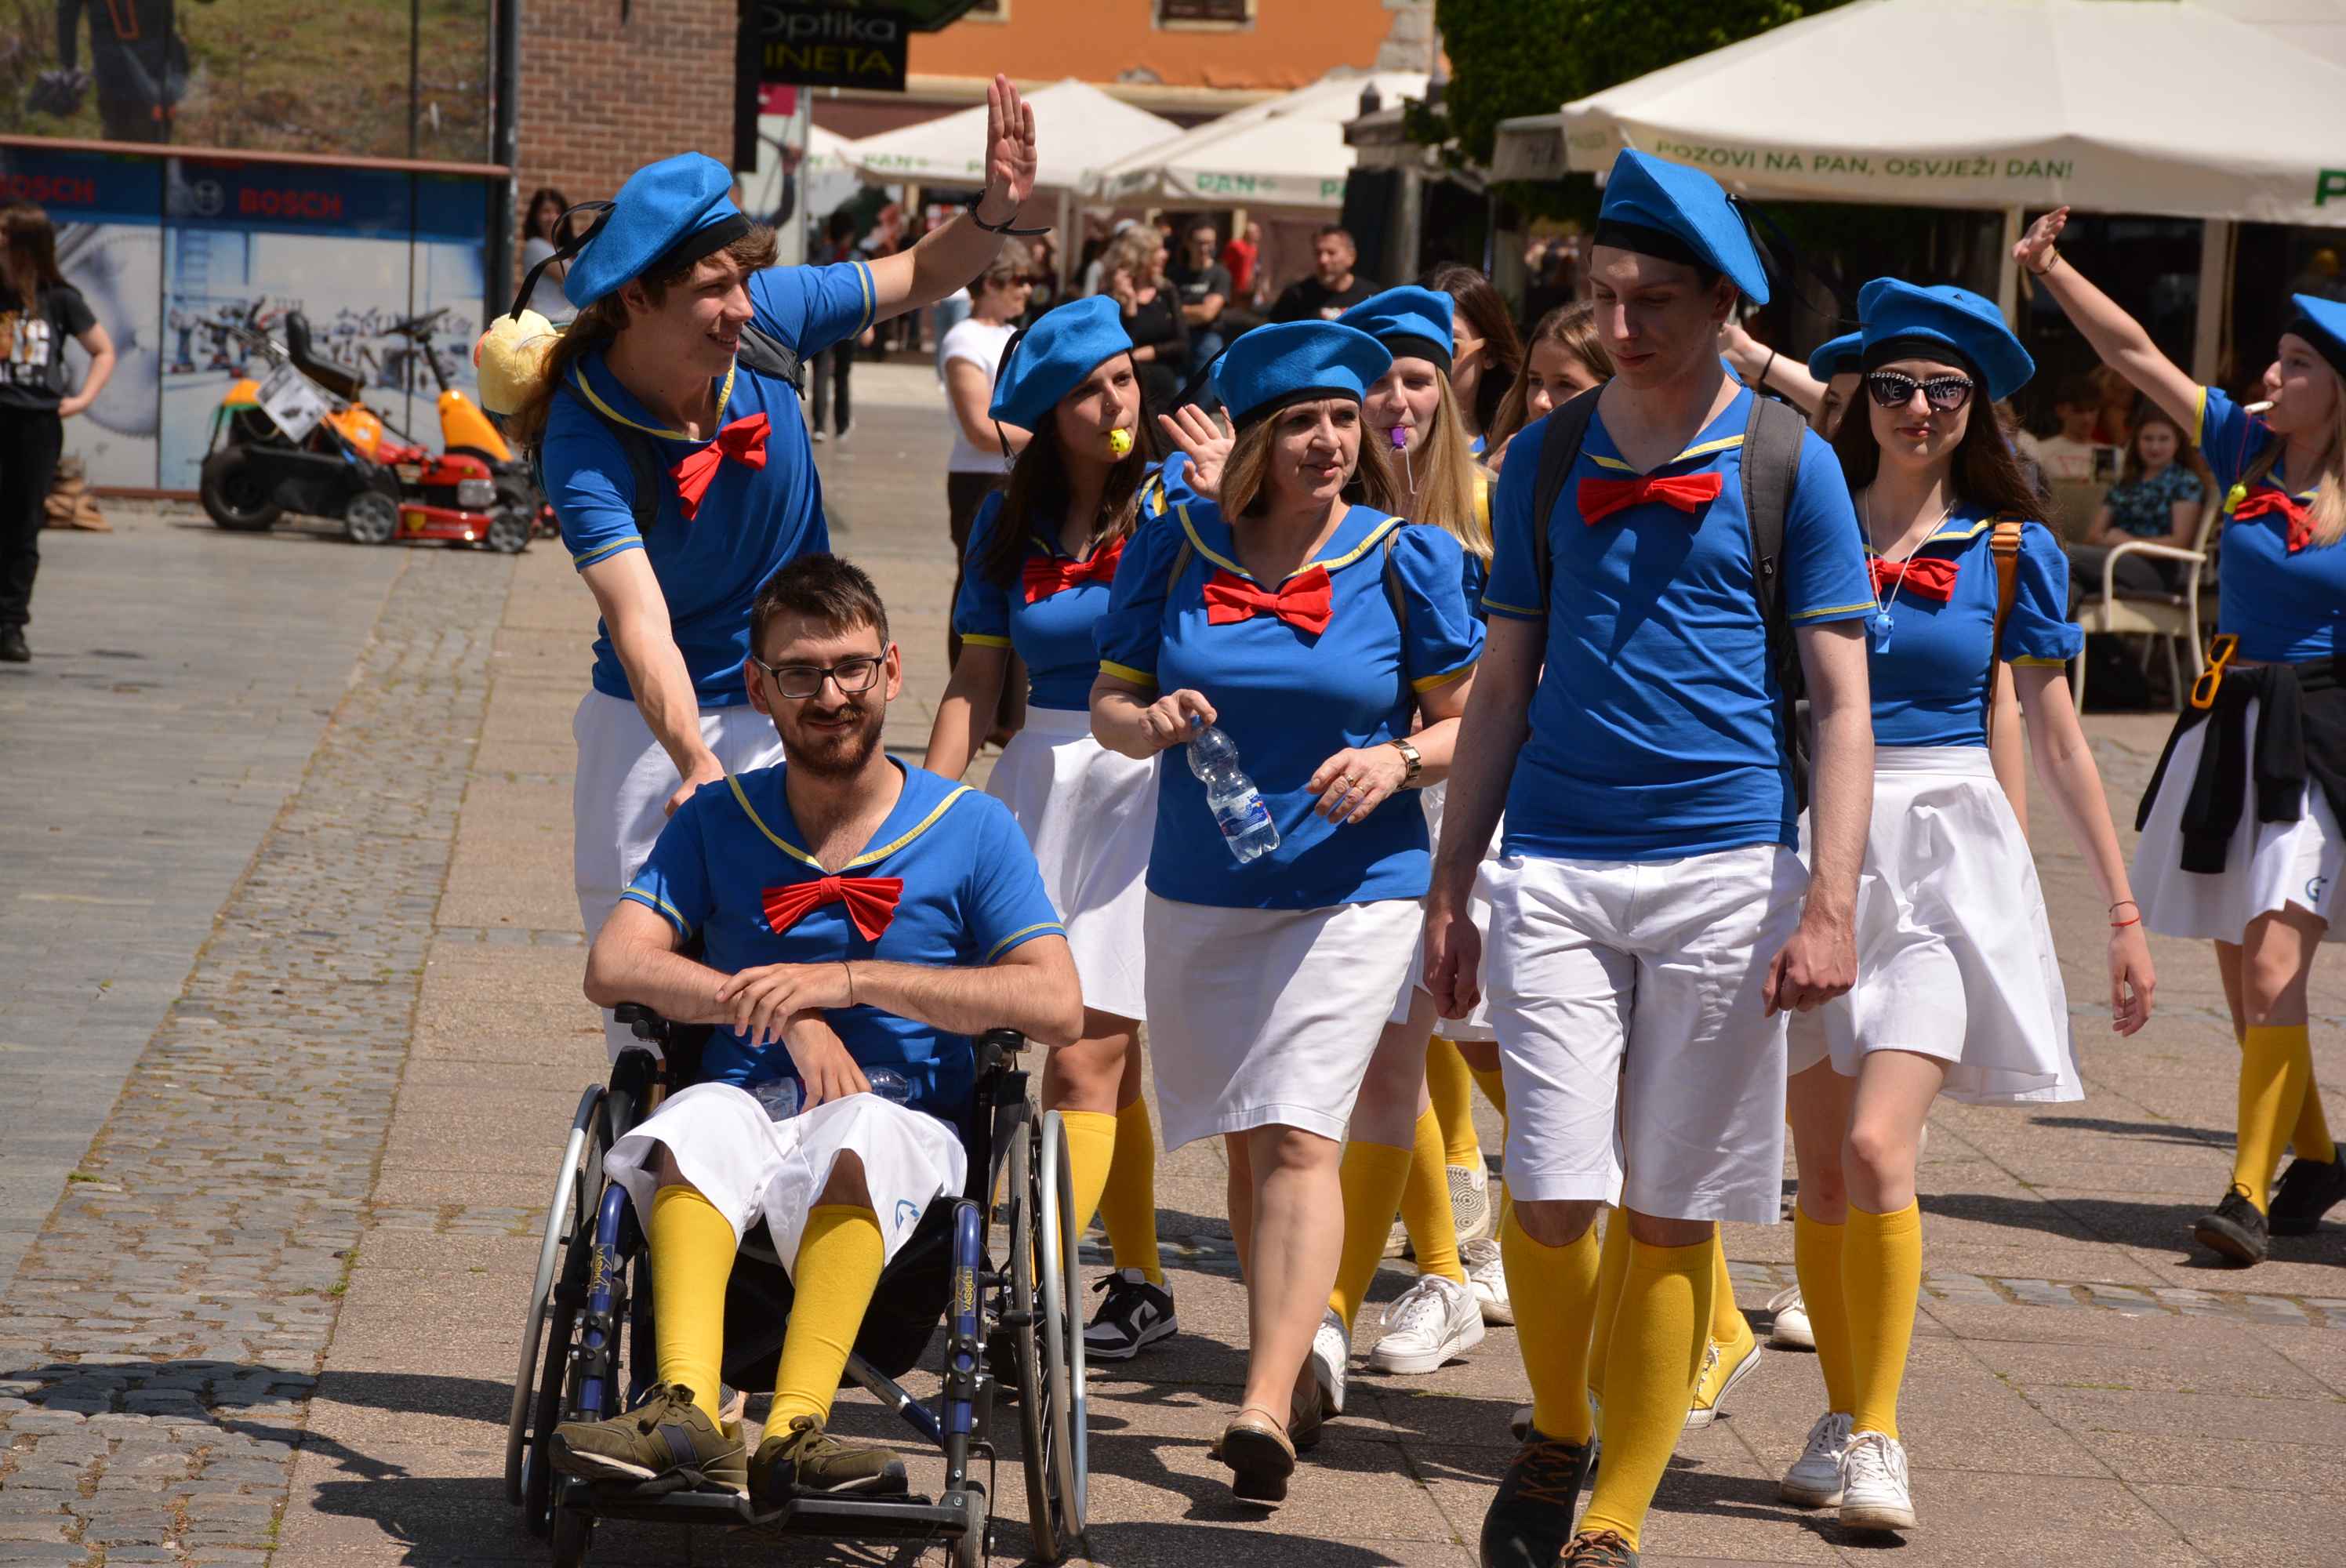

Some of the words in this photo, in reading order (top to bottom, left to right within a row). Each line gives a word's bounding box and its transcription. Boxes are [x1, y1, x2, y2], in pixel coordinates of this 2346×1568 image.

[1655, 139, 1756, 168] POZOVI
[1765, 151, 1803, 170] NA
[1814, 154, 1876, 178] PAN,
[1884, 154, 1997, 177] OSVJEŽI
[2006, 158, 2075, 179] DAN!
[238, 187, 343, 219] BOSCH
